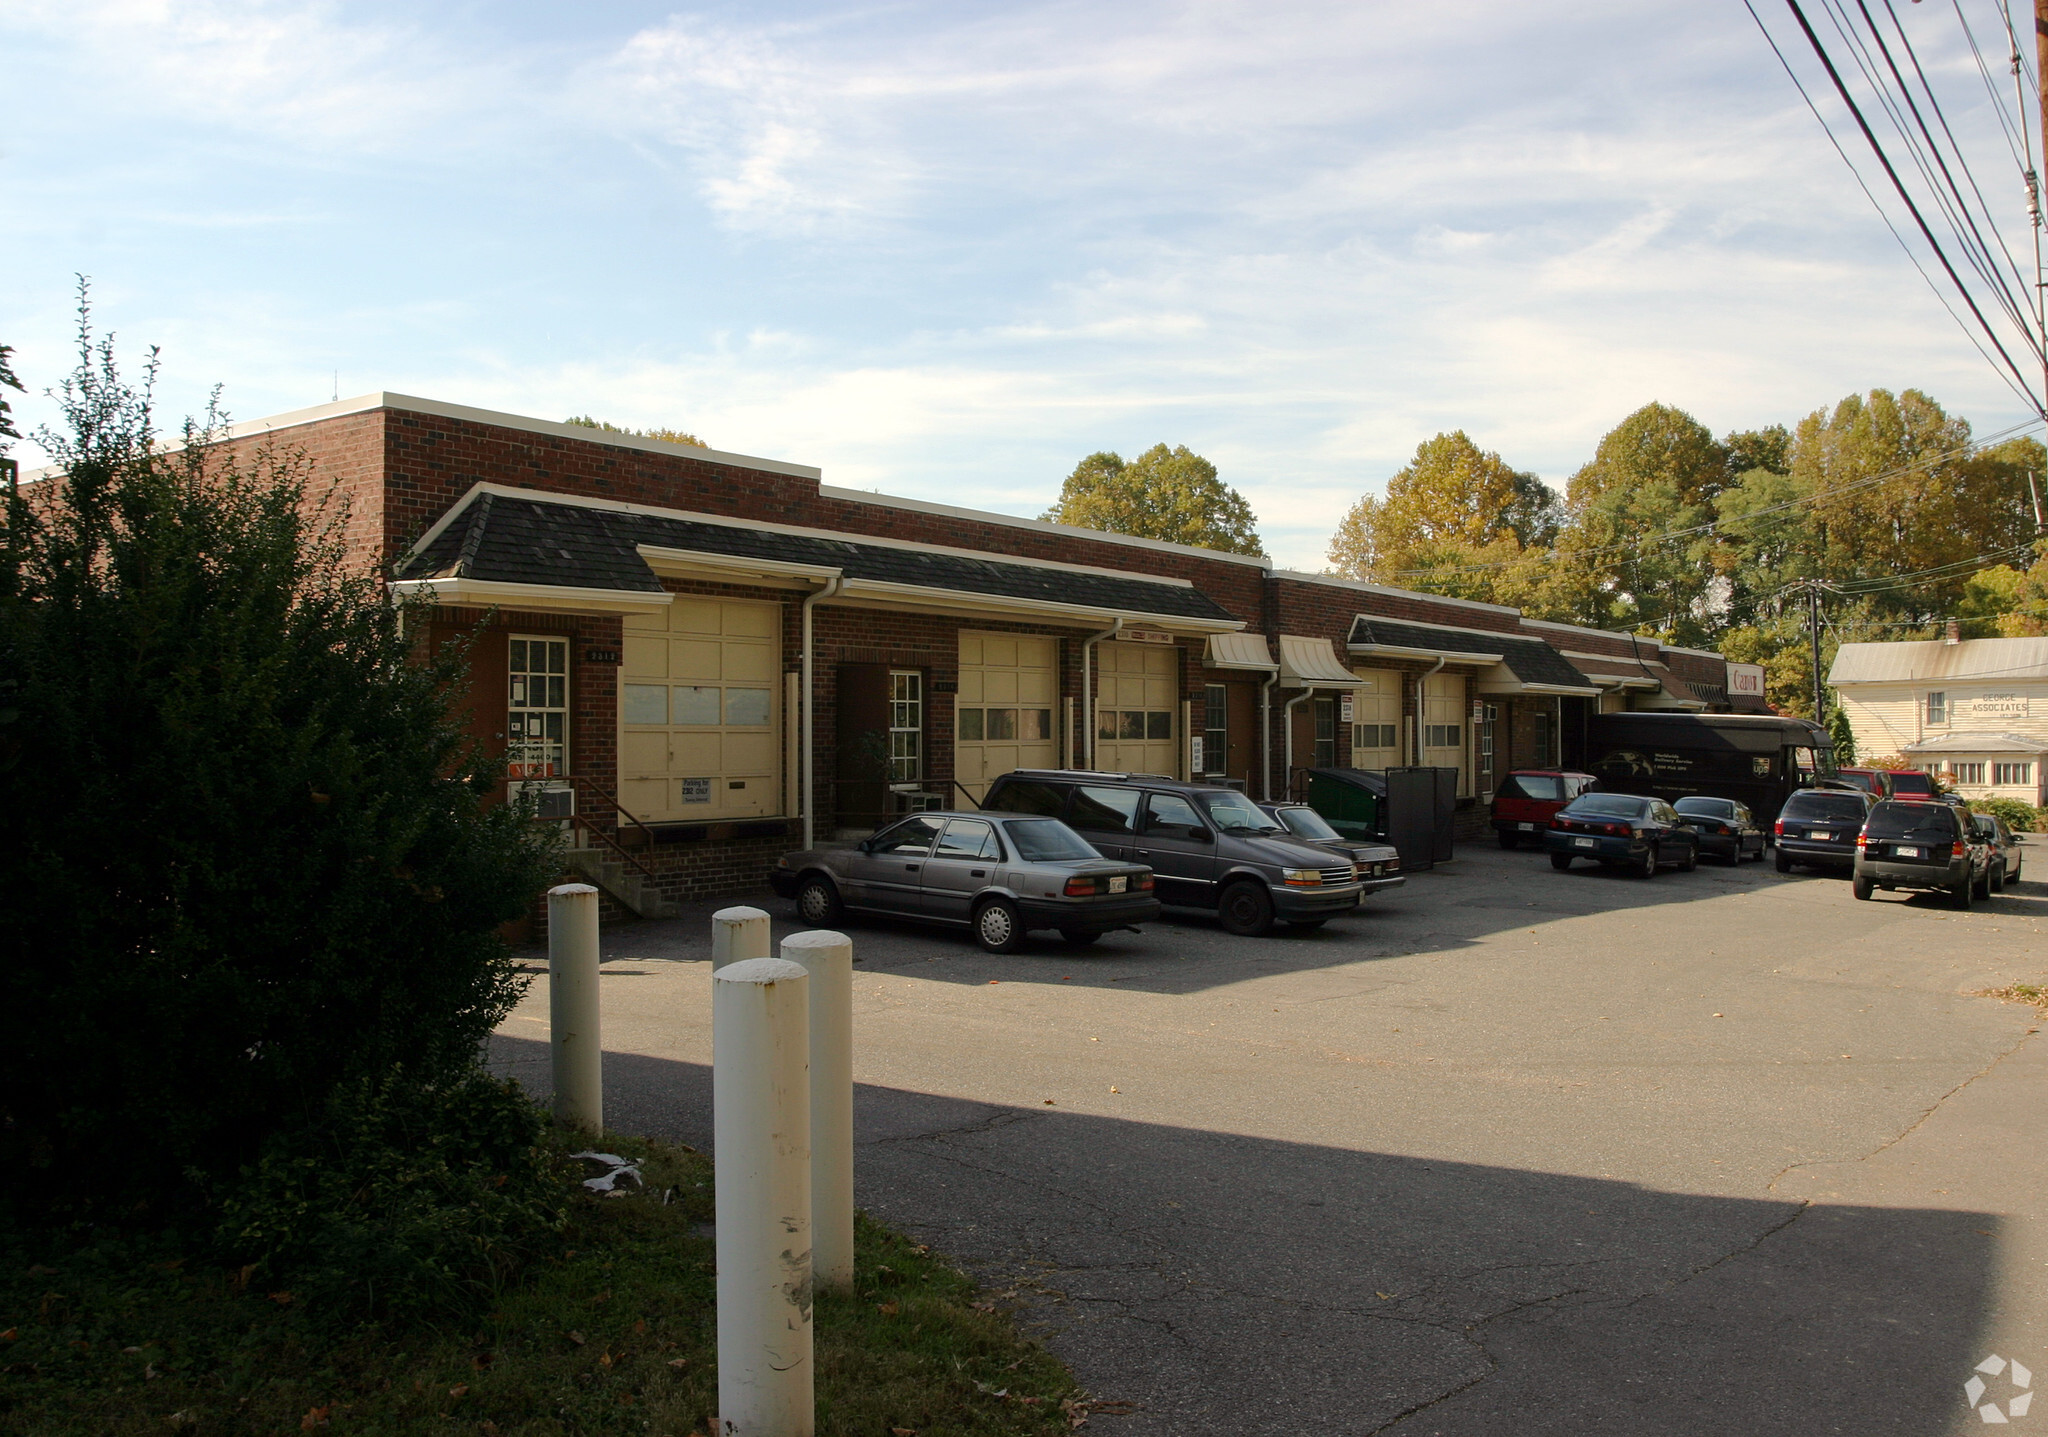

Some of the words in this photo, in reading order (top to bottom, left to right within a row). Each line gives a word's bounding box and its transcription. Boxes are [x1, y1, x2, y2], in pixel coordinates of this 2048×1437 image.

[591, 651, 615, 661] 2312
[1982, 693, 2016, 702] GEORGE
[1972, 703, 2027, 712] ASSOCIATES
[1753, 765, 1769, 776] ups
[683, 779, 702, 788] Parking
